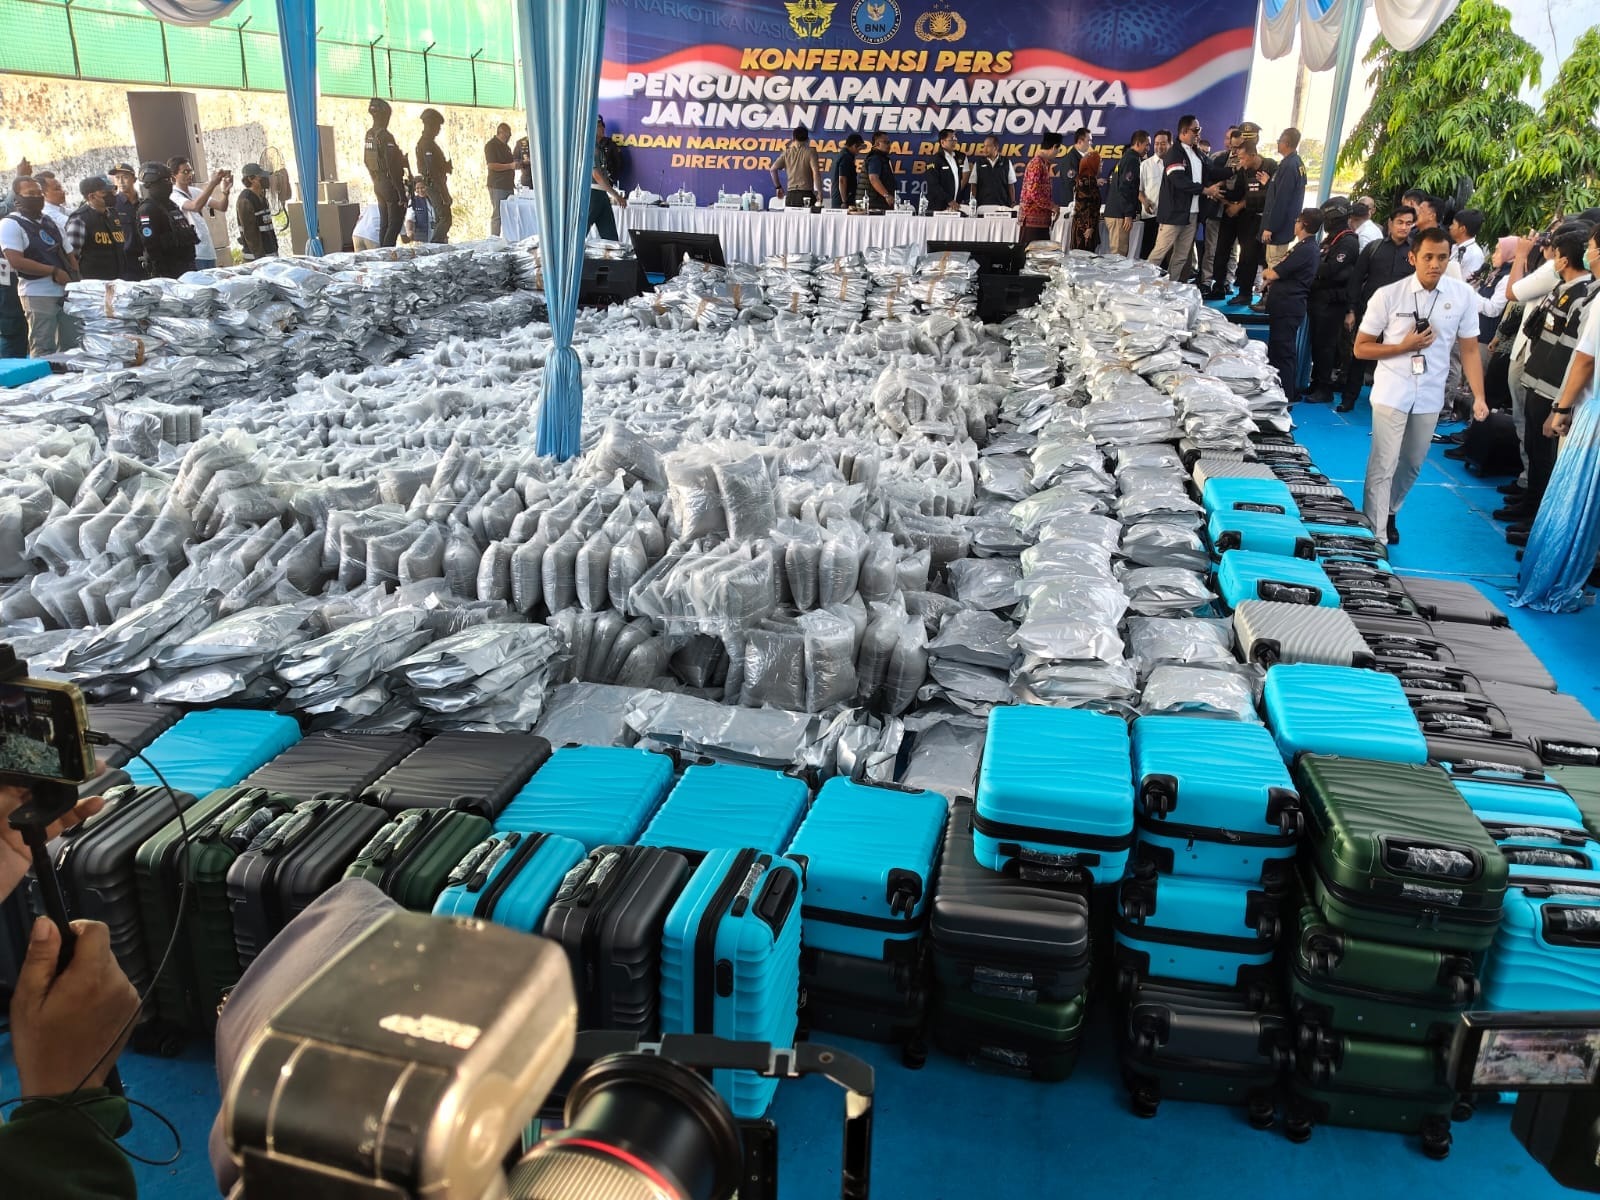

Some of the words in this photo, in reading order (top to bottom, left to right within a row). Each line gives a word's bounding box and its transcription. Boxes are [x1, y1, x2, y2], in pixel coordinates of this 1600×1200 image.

[634, 0, 741, 31] NARKOTIKA
[864, 24, 886, 32] BNN
[740, 47, 927, 72] KONFERENSI
[935, 50, 1013, 73] PERS
[624, 73, 912, 104] PENGUNGKAPAN
[917, 78, 1128, 107] NARKOTIKA
[641, 102, 818, 131] JARINGAN
[823, 106, 1107, 135] INTERNASIONAL
[612, 133, 682, 149] BADAN
[687, 135, 795, 153] NARKOTIK
[672, 153, 780, 171] DIREKTOR
